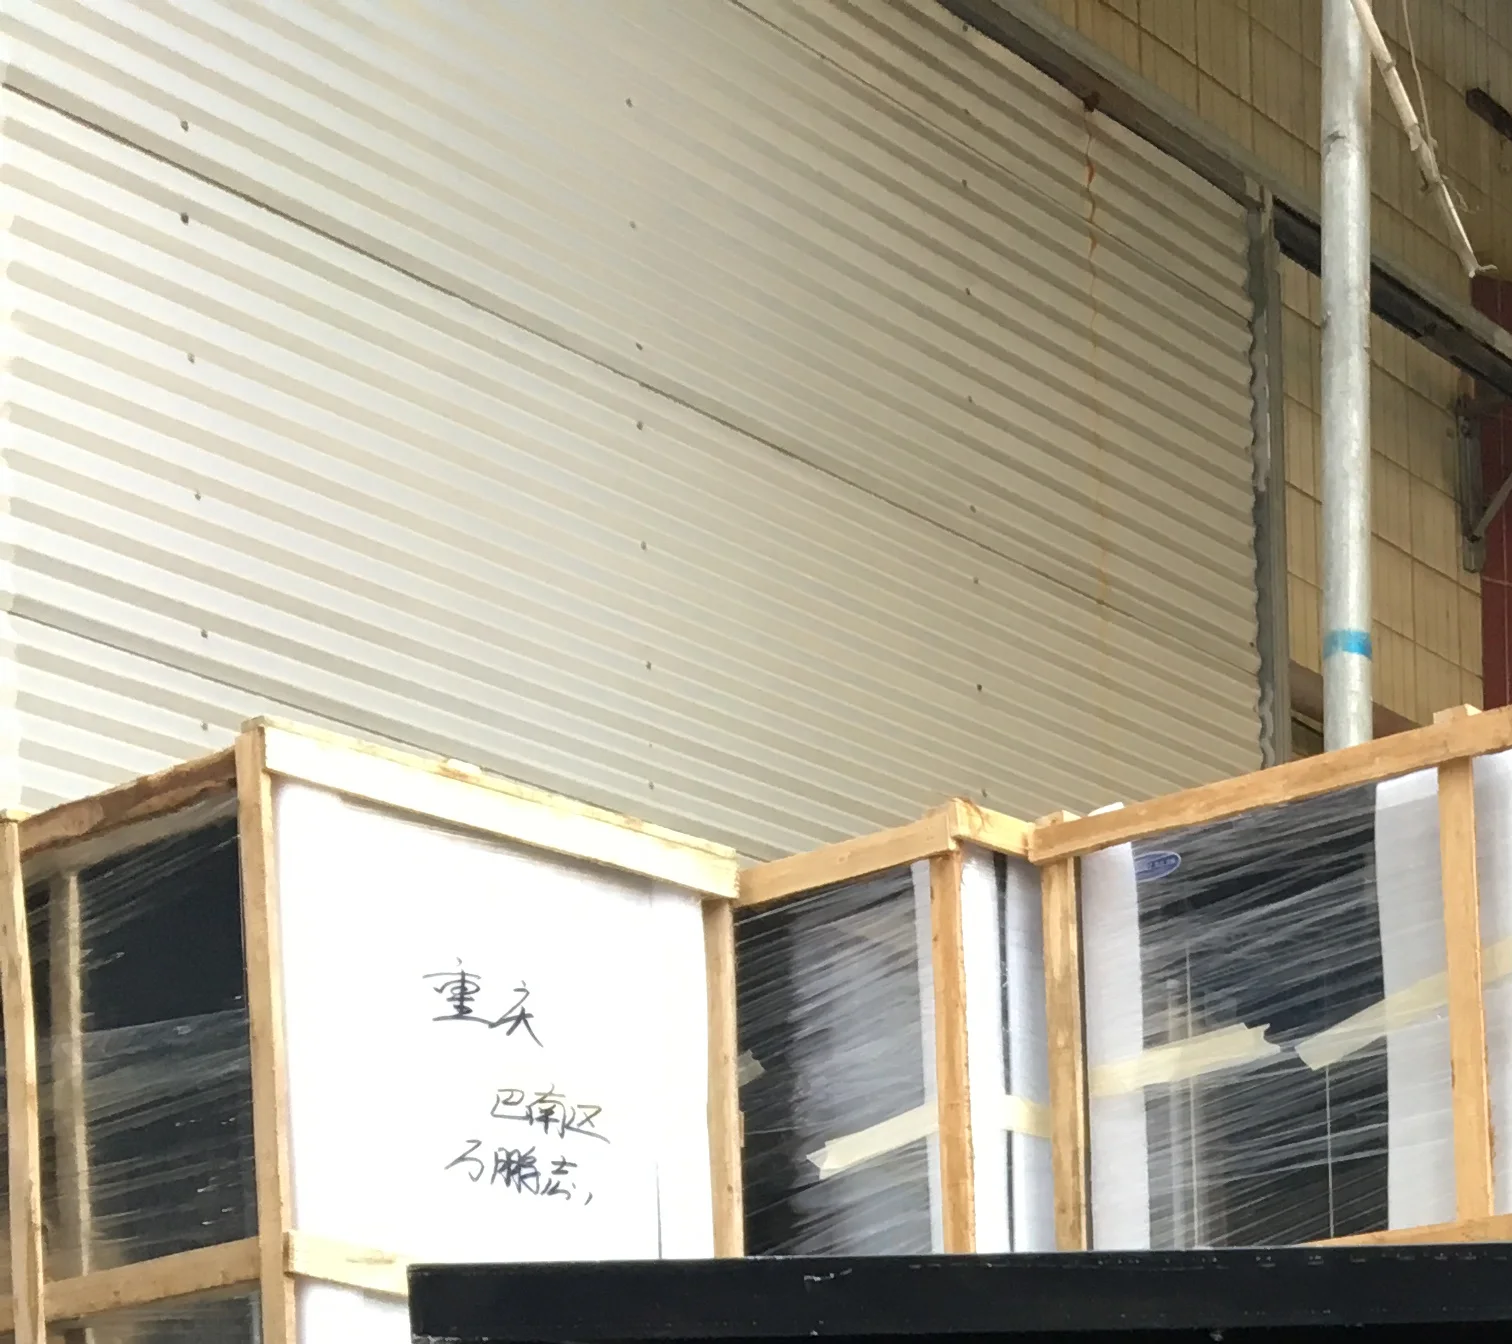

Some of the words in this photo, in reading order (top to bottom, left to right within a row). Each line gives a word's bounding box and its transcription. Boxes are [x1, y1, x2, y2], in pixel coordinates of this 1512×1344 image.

[422, 957, 544, 1048] 重庆
[490, 1083, 611, 1144] 巴南区
